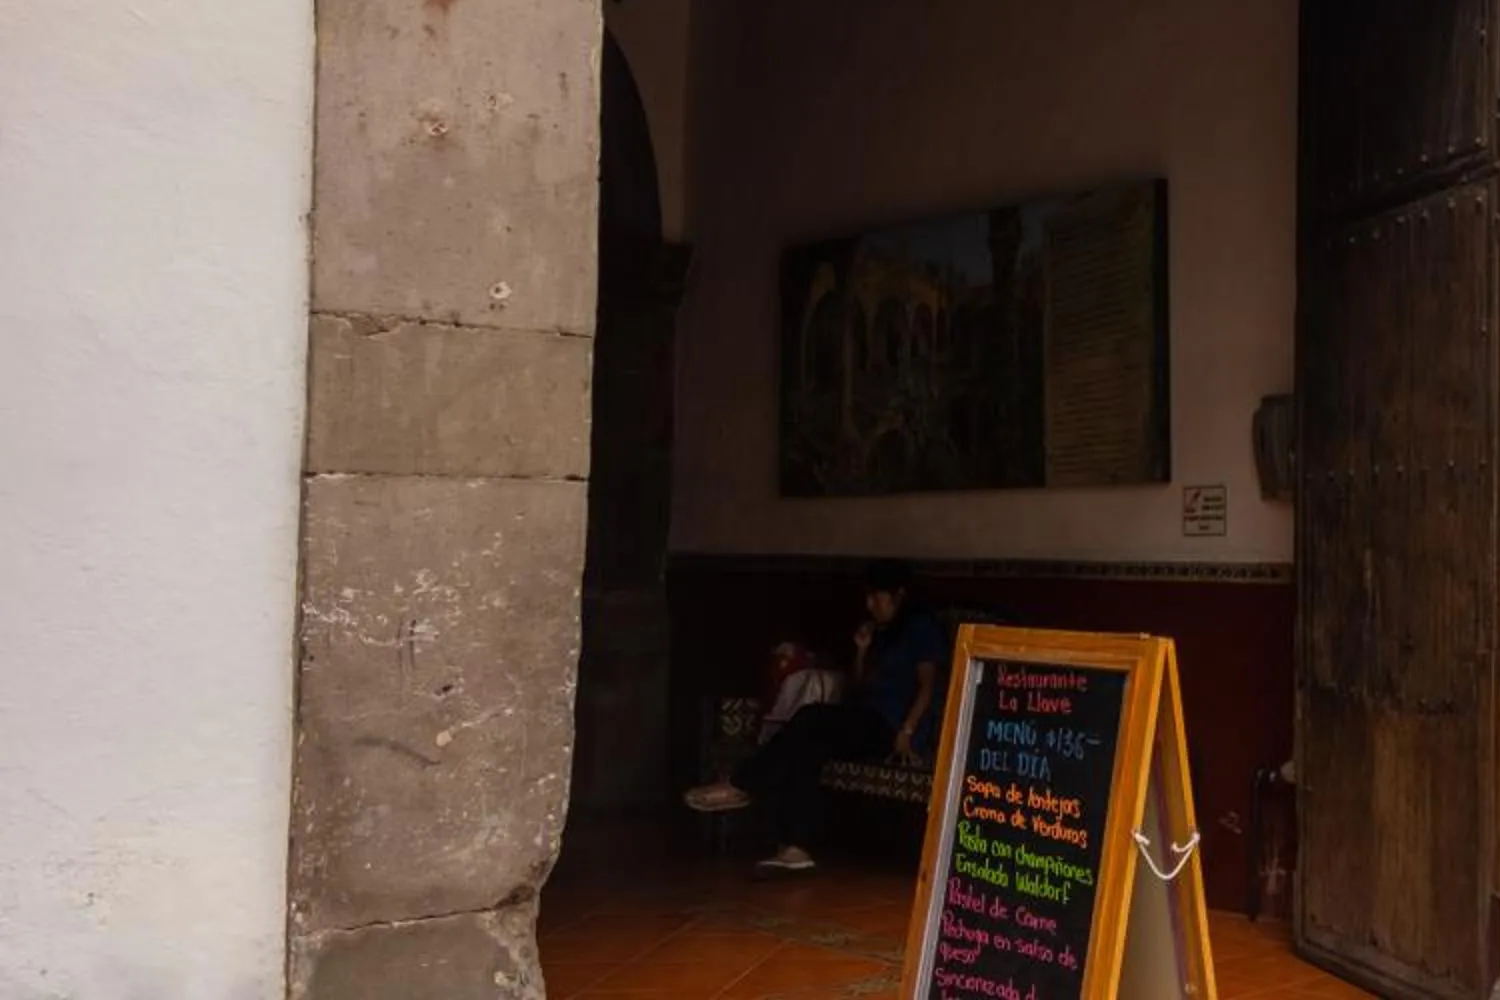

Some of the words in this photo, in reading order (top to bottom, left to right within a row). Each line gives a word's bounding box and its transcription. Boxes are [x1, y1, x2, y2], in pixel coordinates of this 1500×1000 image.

[998, 664, 1088, 693] Restaurante
[999, 690, 1017, 712] La
[1027, 690, 1073, 714] Llave
[979, 747, 1009, 772] DEL
[966, 774, 1001, 799] Sopa
[1005, 782, 1024, 805] de
[963, 795, 1006, 824] Crema
[1010, 807, 1027, 831] de
[991, 839, 1013, 859] con
[955, 852, 1009, 889] Ensalada
[948, 876, 986, 914] Pastel
[988, 895, 1009, 920] de
[1015, 905, 1058, 936] Carne
[993, 933, 1012, 952] en
[1015, 938, 1054, 964] salsa
